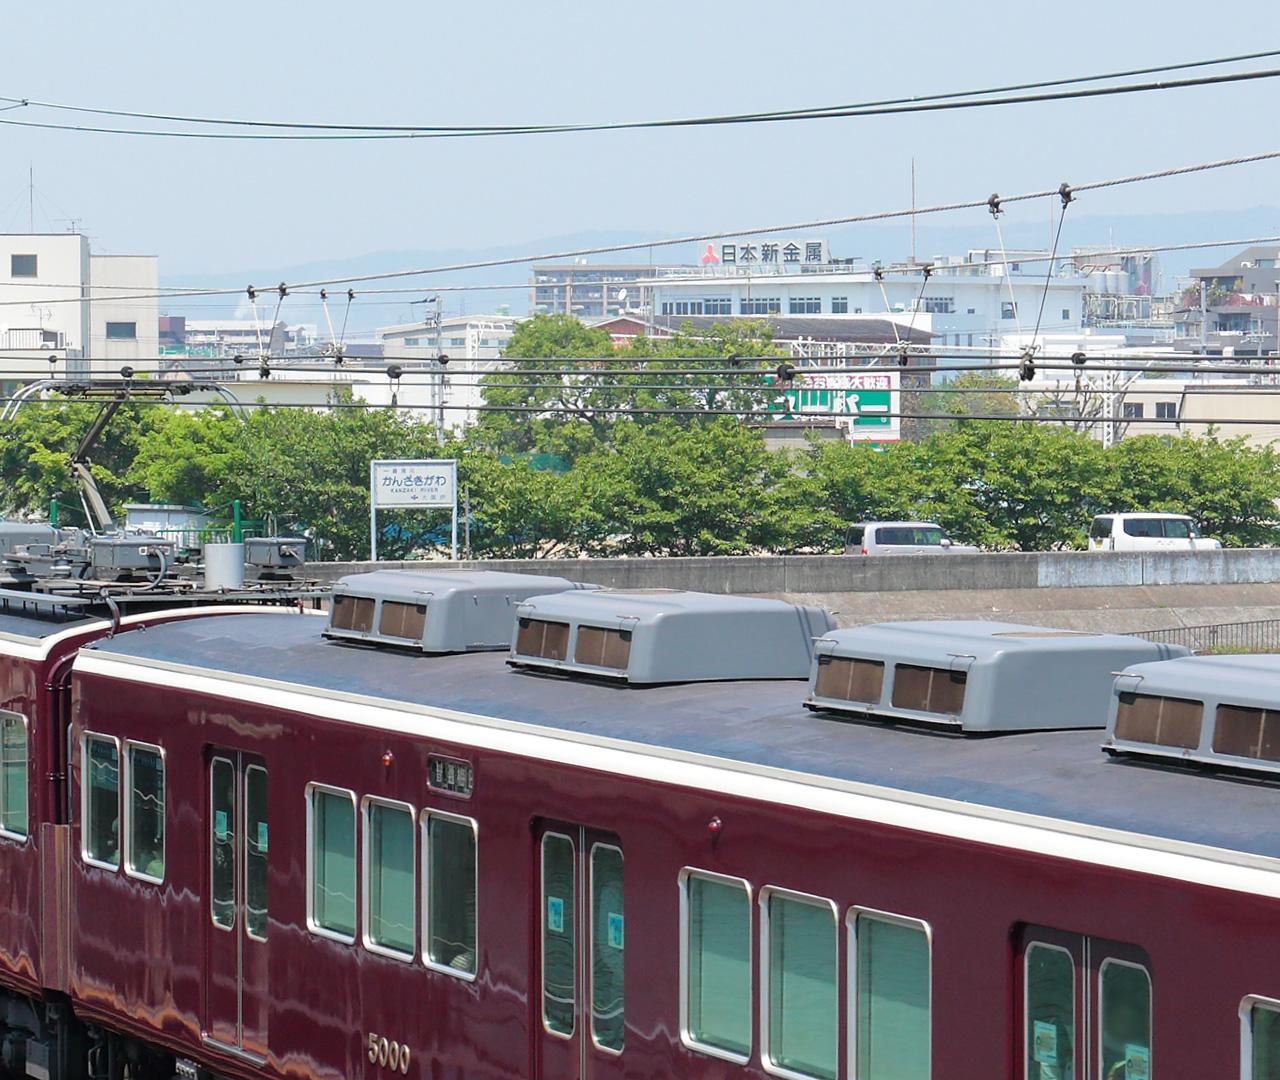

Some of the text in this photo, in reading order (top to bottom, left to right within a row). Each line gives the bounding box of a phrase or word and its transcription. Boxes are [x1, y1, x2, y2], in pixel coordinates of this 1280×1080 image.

[722, 242, 822, 263] 日本新金属
[382, 474, 447, 487] かんざきがわ
[368, 1032, 410, 1075] 5000
